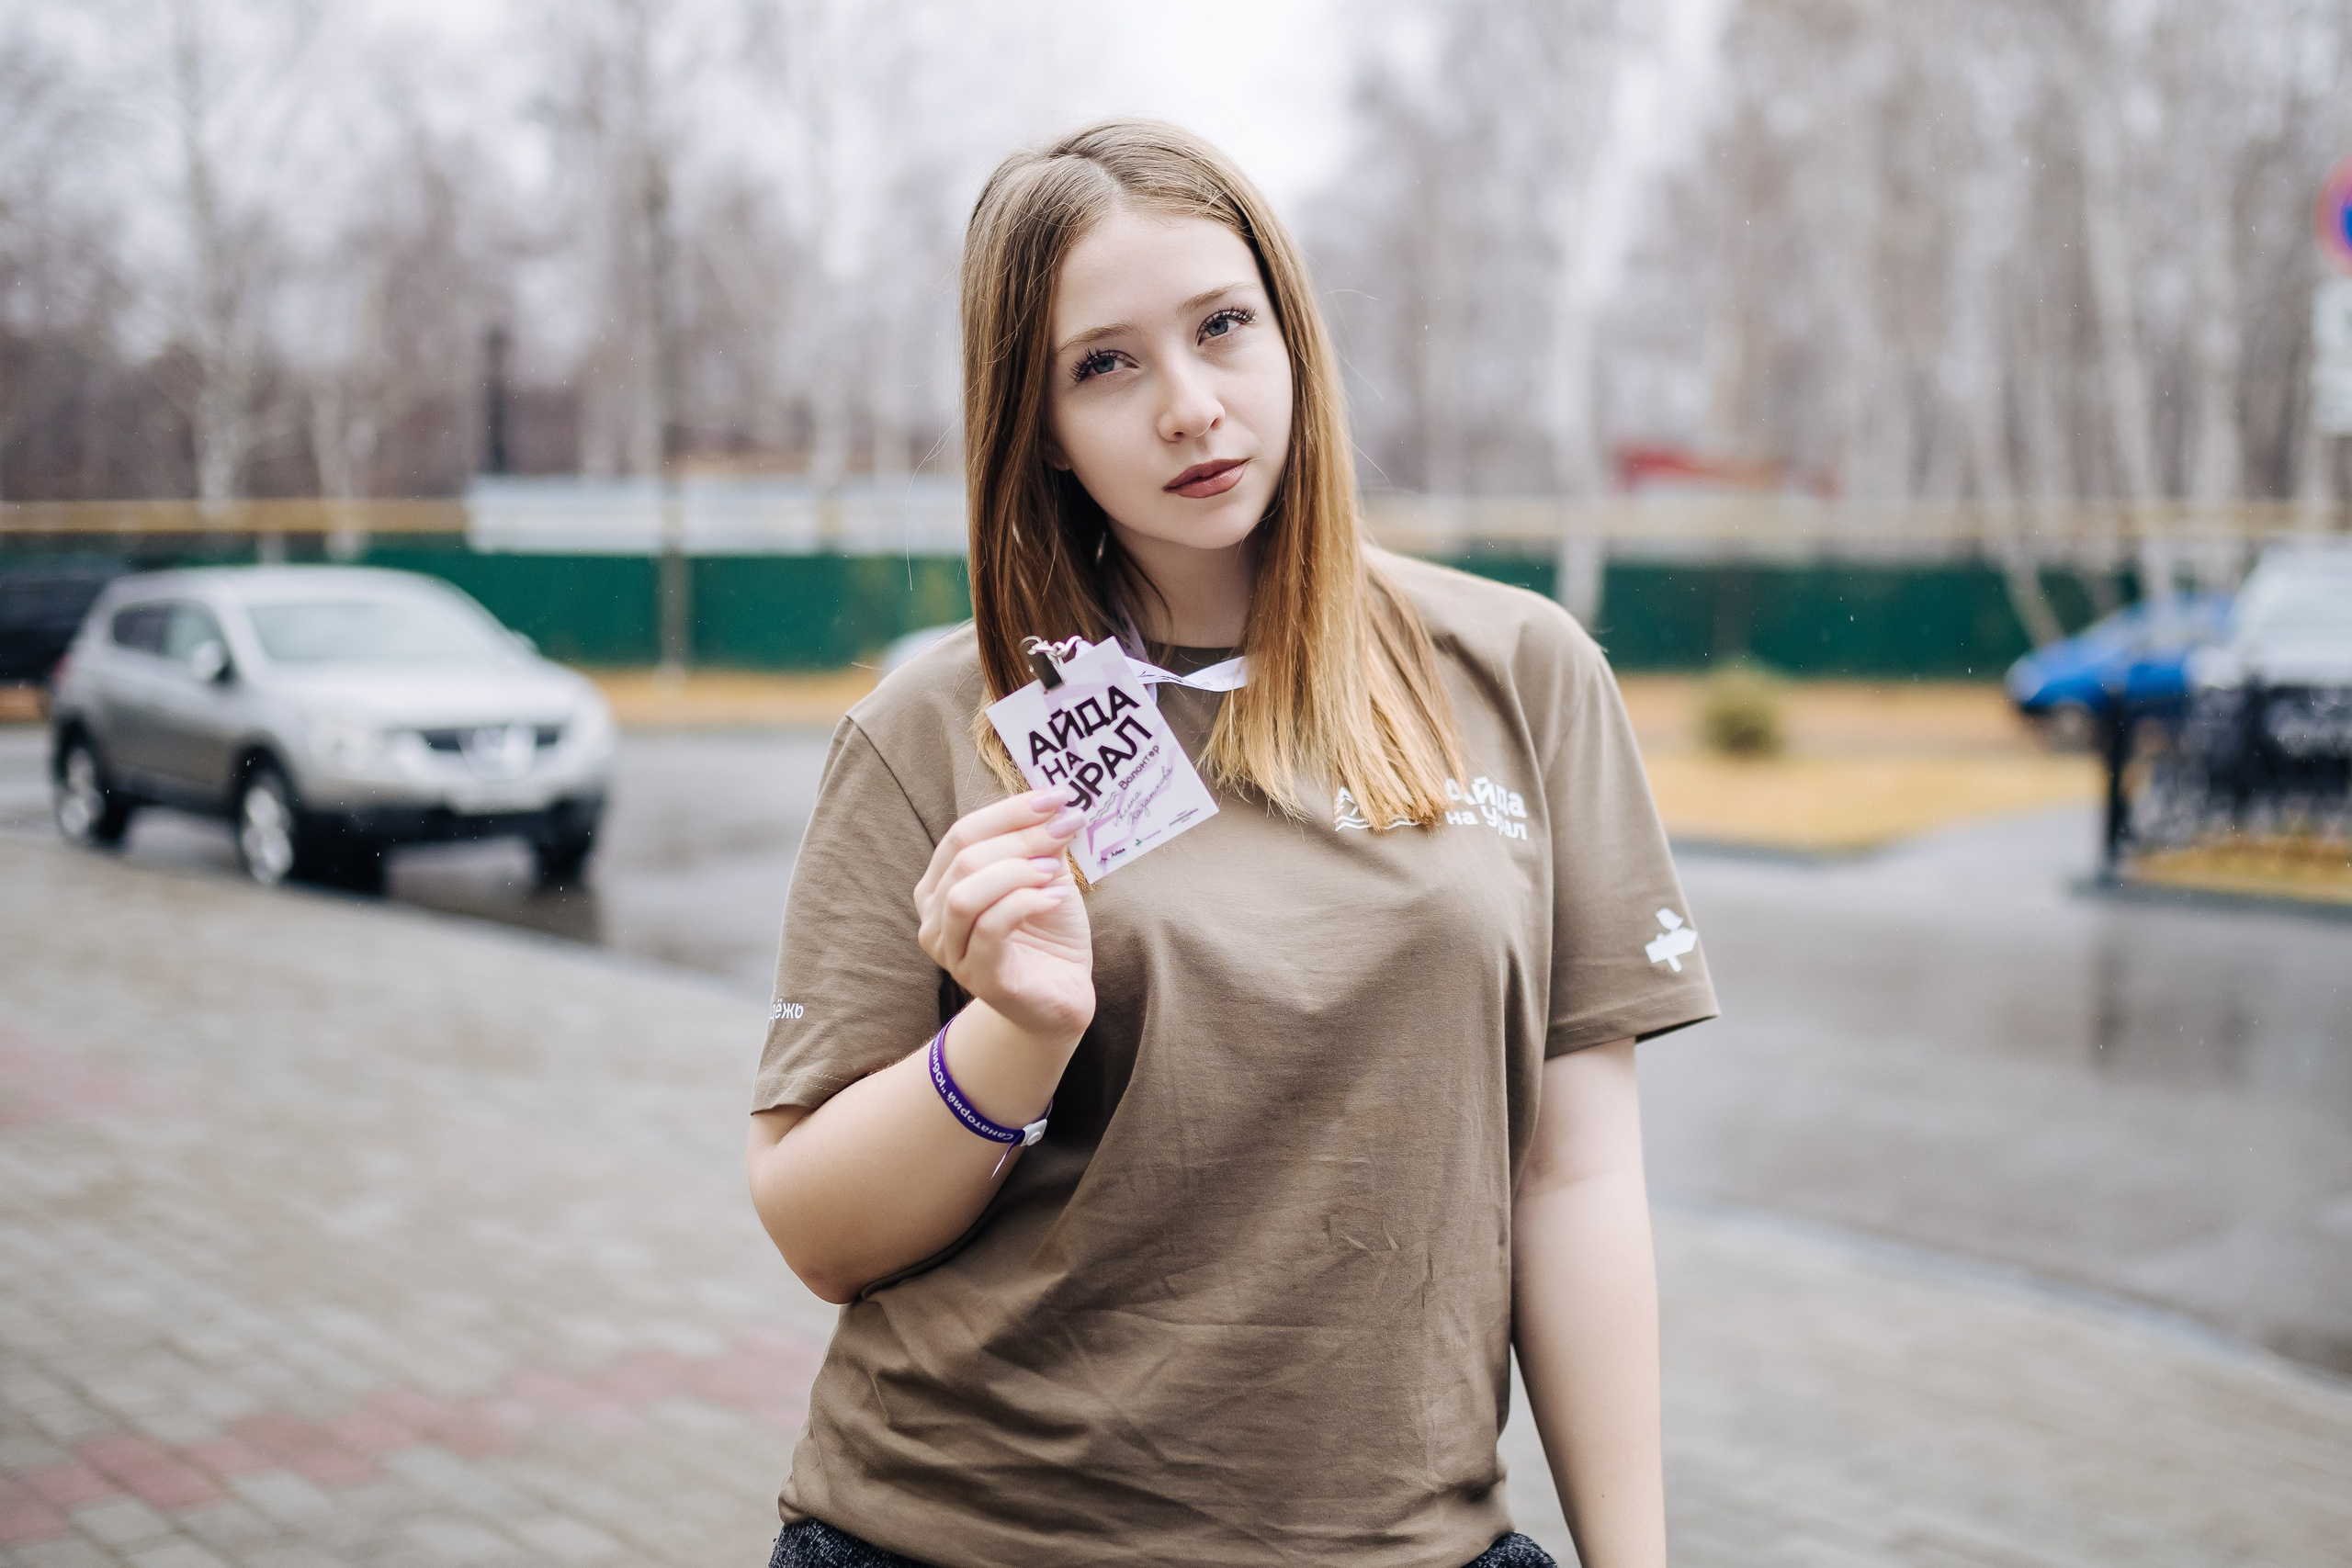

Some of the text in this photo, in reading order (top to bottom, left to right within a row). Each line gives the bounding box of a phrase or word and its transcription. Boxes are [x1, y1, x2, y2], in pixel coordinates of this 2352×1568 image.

[1028, 685, 1141, 766] АЙДА
[1041, 750, 1085, 786] НА
[1065, 715, 1153, 812] УРАЛ
[1444, 810, 1479, 826] на
[947, 1090, 1014, 1141] Санаторий
